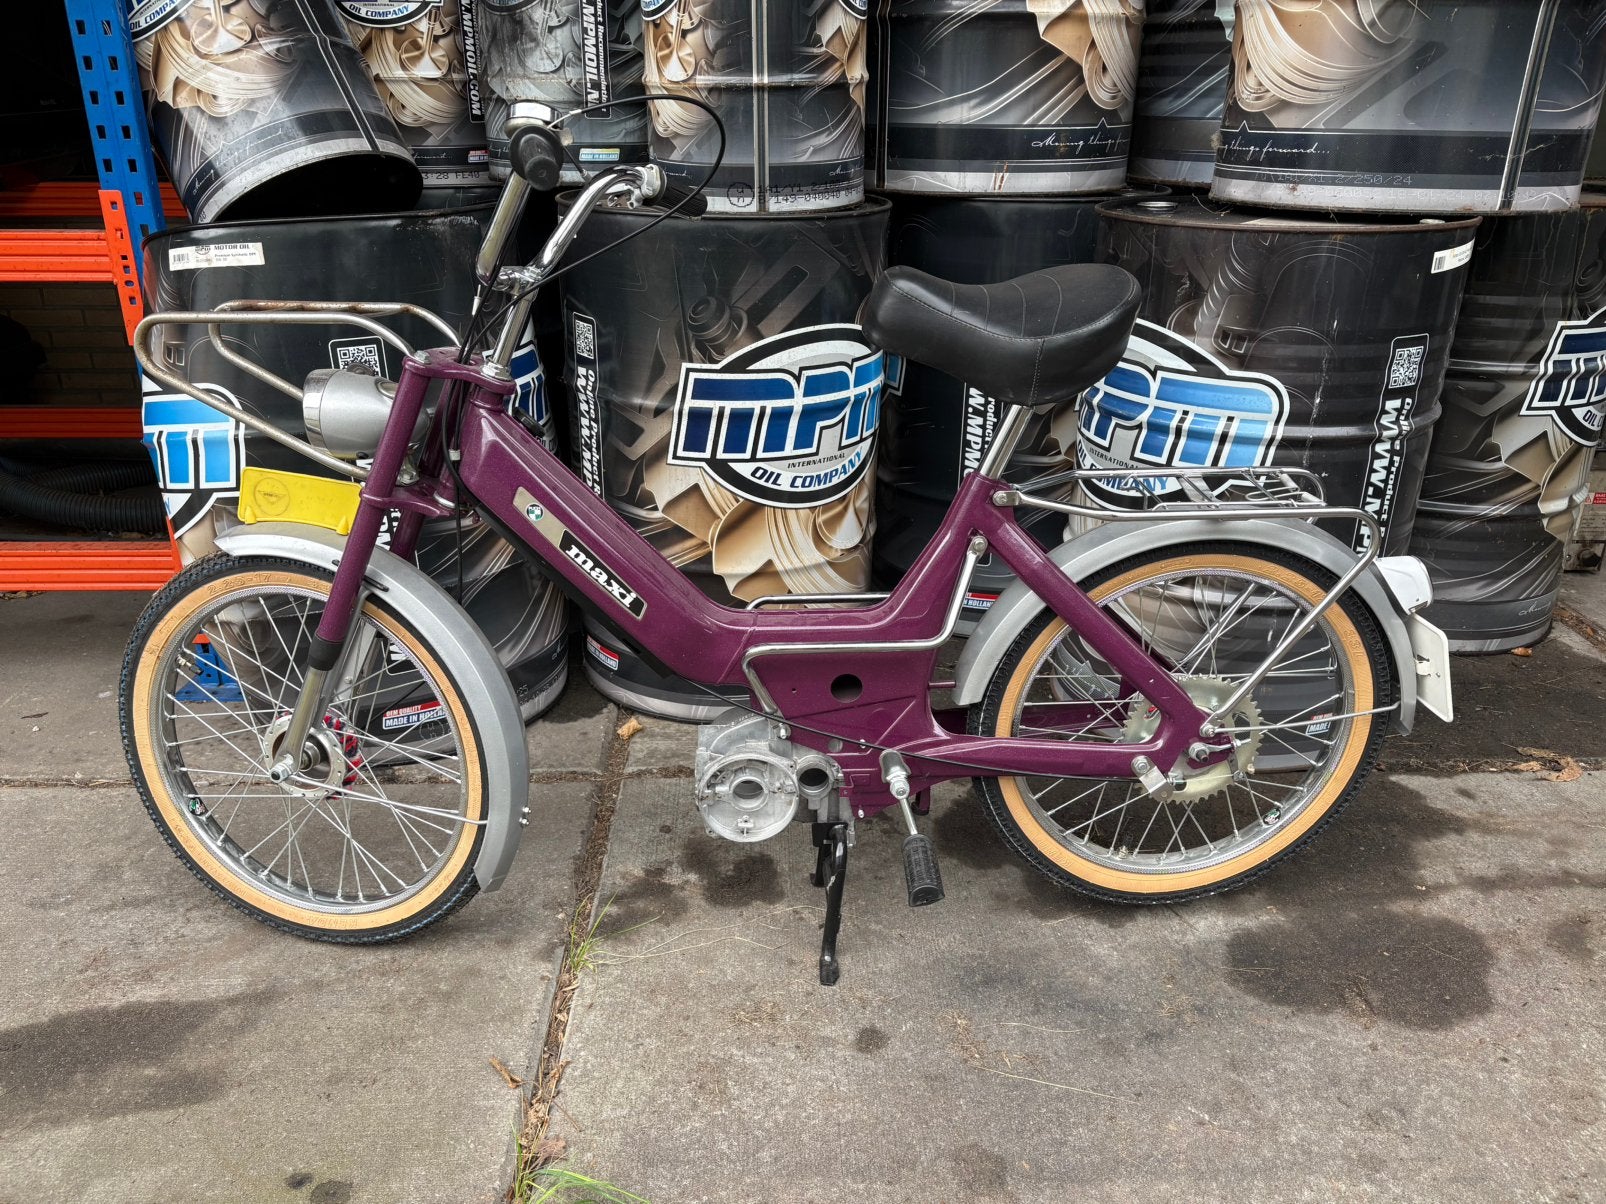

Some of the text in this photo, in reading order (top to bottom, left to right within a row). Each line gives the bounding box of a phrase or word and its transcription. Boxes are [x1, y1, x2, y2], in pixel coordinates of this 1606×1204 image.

[349, 3, 410, 18] OIL COMPANY
[129, 20, 142, 31] OIL
[1031, 131, 1085, 155] Moving
[588, 369, 597, 418] Online
[1582, 409, 1596, 427] OIL
[591, 422, 600, 482] Product
[787, 452, 846, 469] INTERNATIONAL
[1380, 397, 1413, 522] Online Product
[749, 450, 864, 490] OIL COMPANY
[565, 544, 638, 609] maxi
[400, 704, 422, 715] QUALITY
[385, 713, 408, 727] MADE
[409, 712, 418, 723] IN
[1308, 721, 1329, 733] MADE
